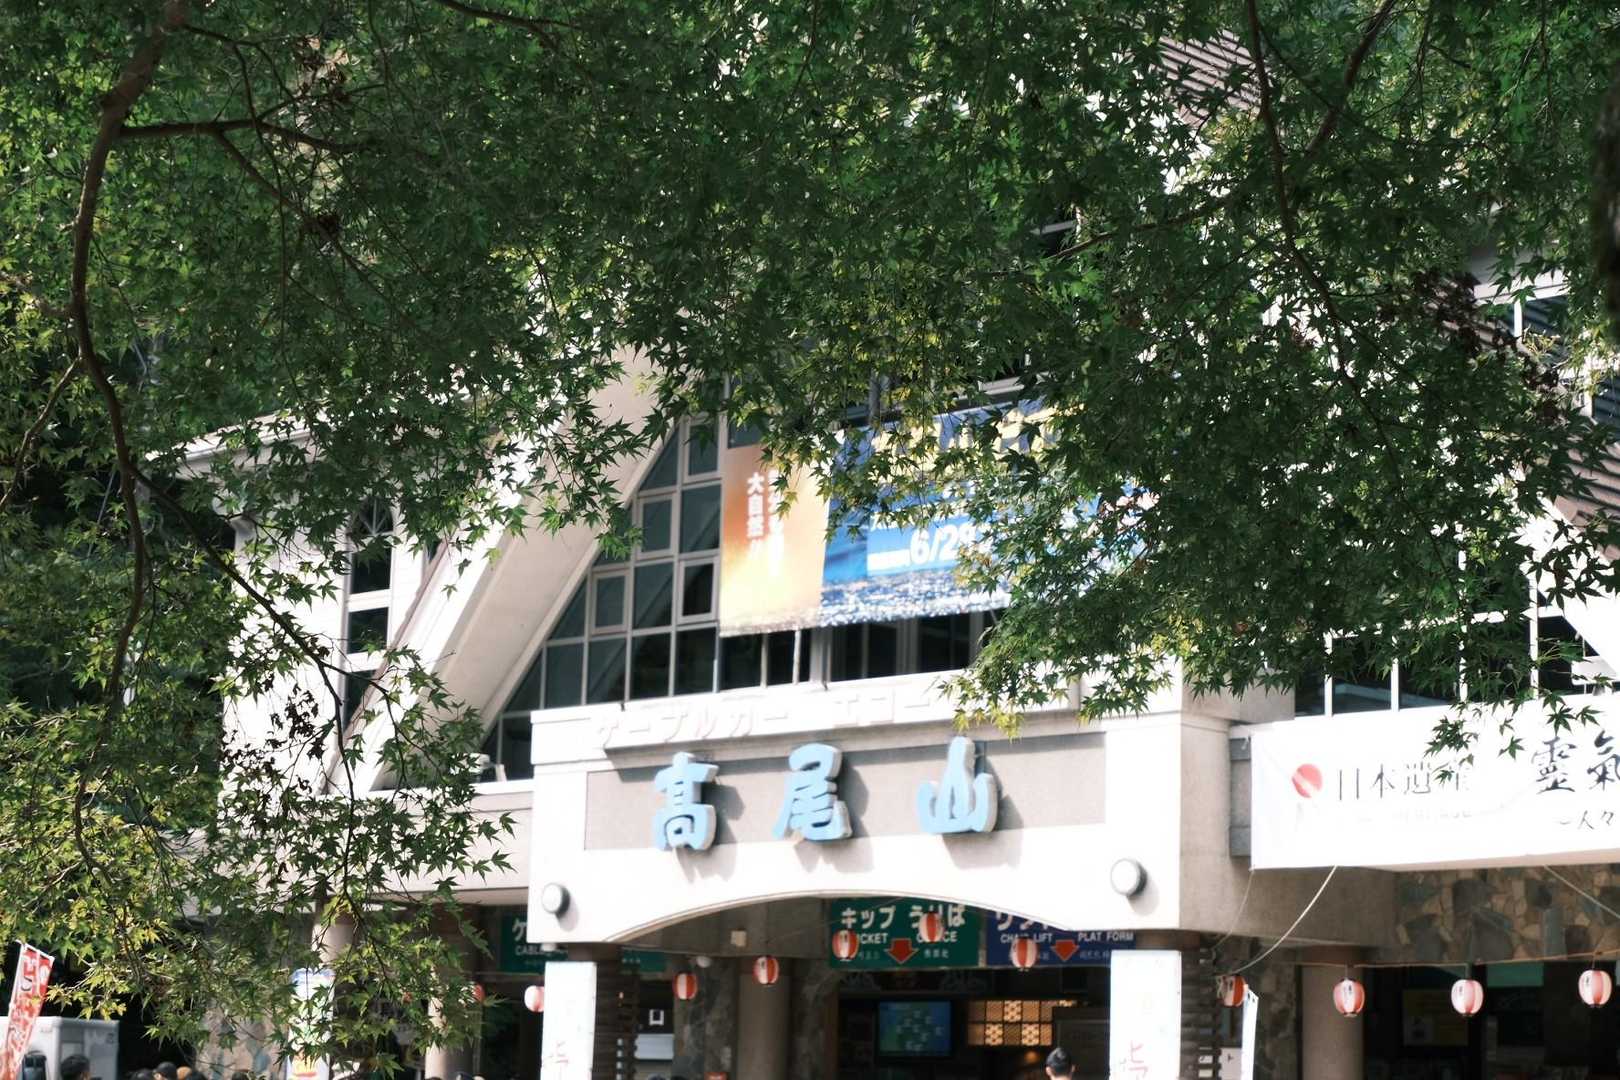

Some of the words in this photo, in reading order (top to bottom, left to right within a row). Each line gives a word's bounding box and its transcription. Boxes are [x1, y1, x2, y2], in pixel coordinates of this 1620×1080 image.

[841, 906, 896, 929] キップ
[1077, 932, 1102, 943] PLAT
[1106, 931, 1134, 942] FORM
